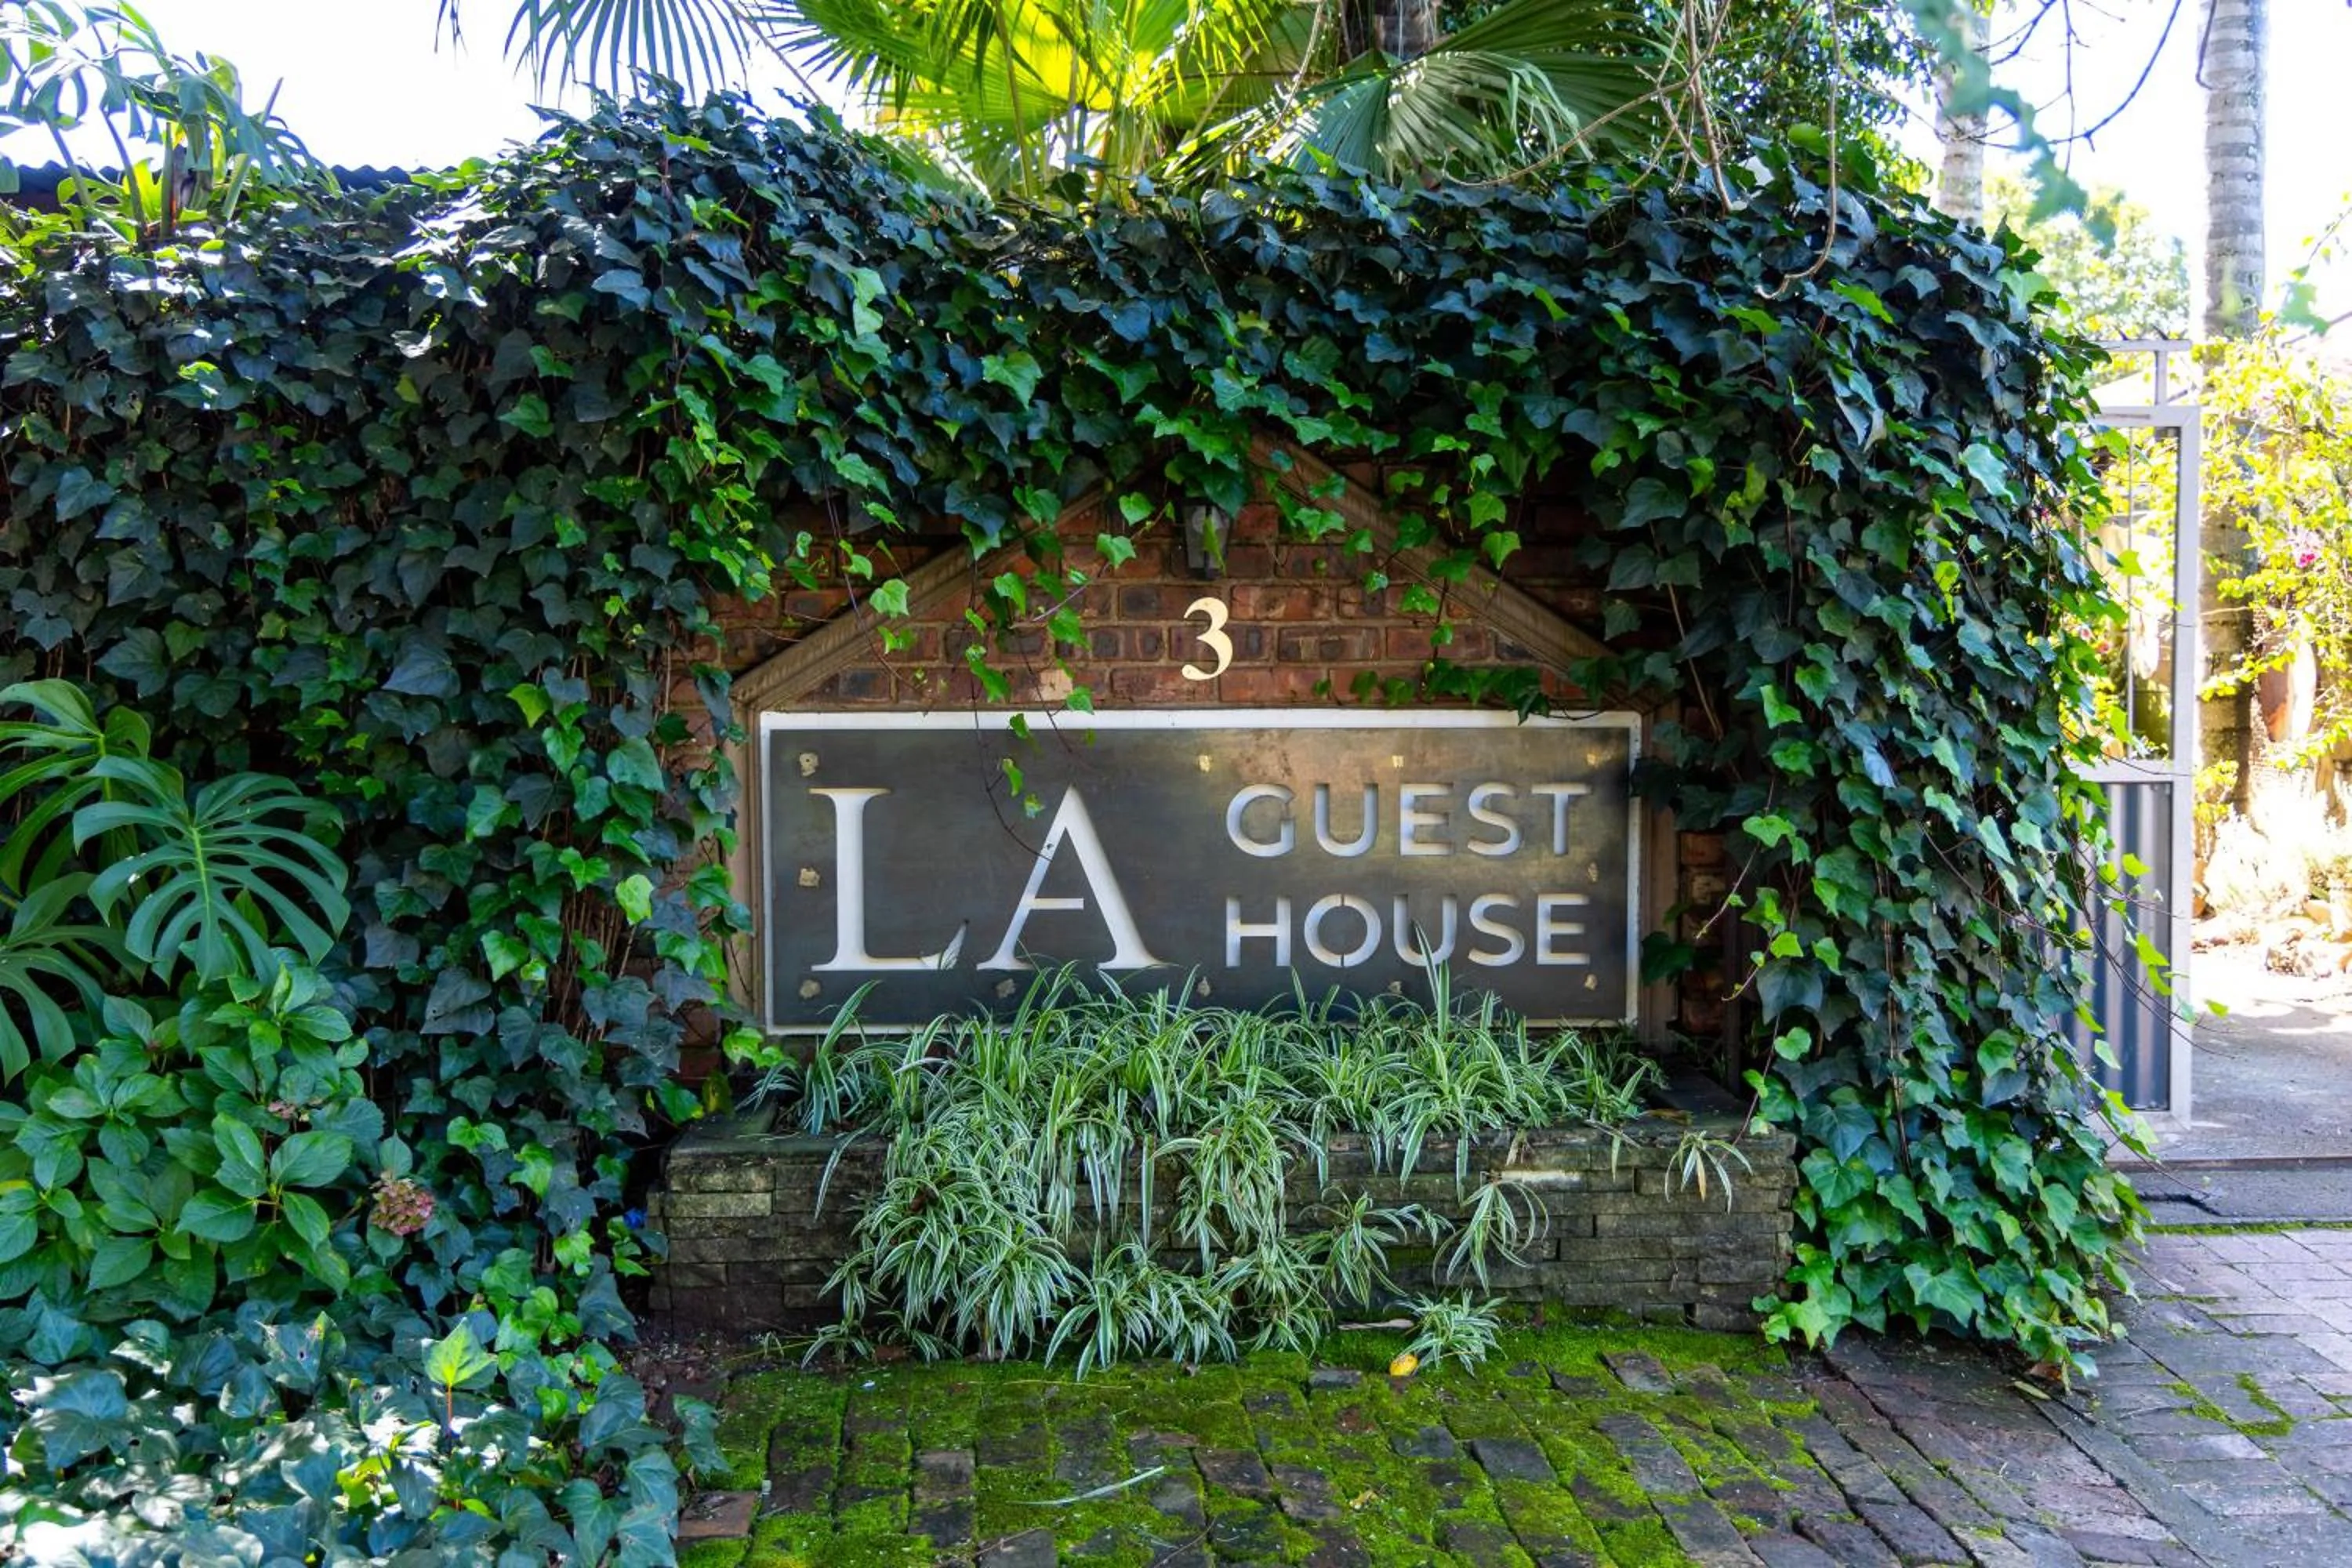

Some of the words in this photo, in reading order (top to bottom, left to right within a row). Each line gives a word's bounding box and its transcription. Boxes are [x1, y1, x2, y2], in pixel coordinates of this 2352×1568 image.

[1181, 597, 1232, 680] 3
[1225, 783, 1591, 857] GUEST
[808, 784, 1166, 970] LA
[1225, 893, 1590, 967] HOUSE
